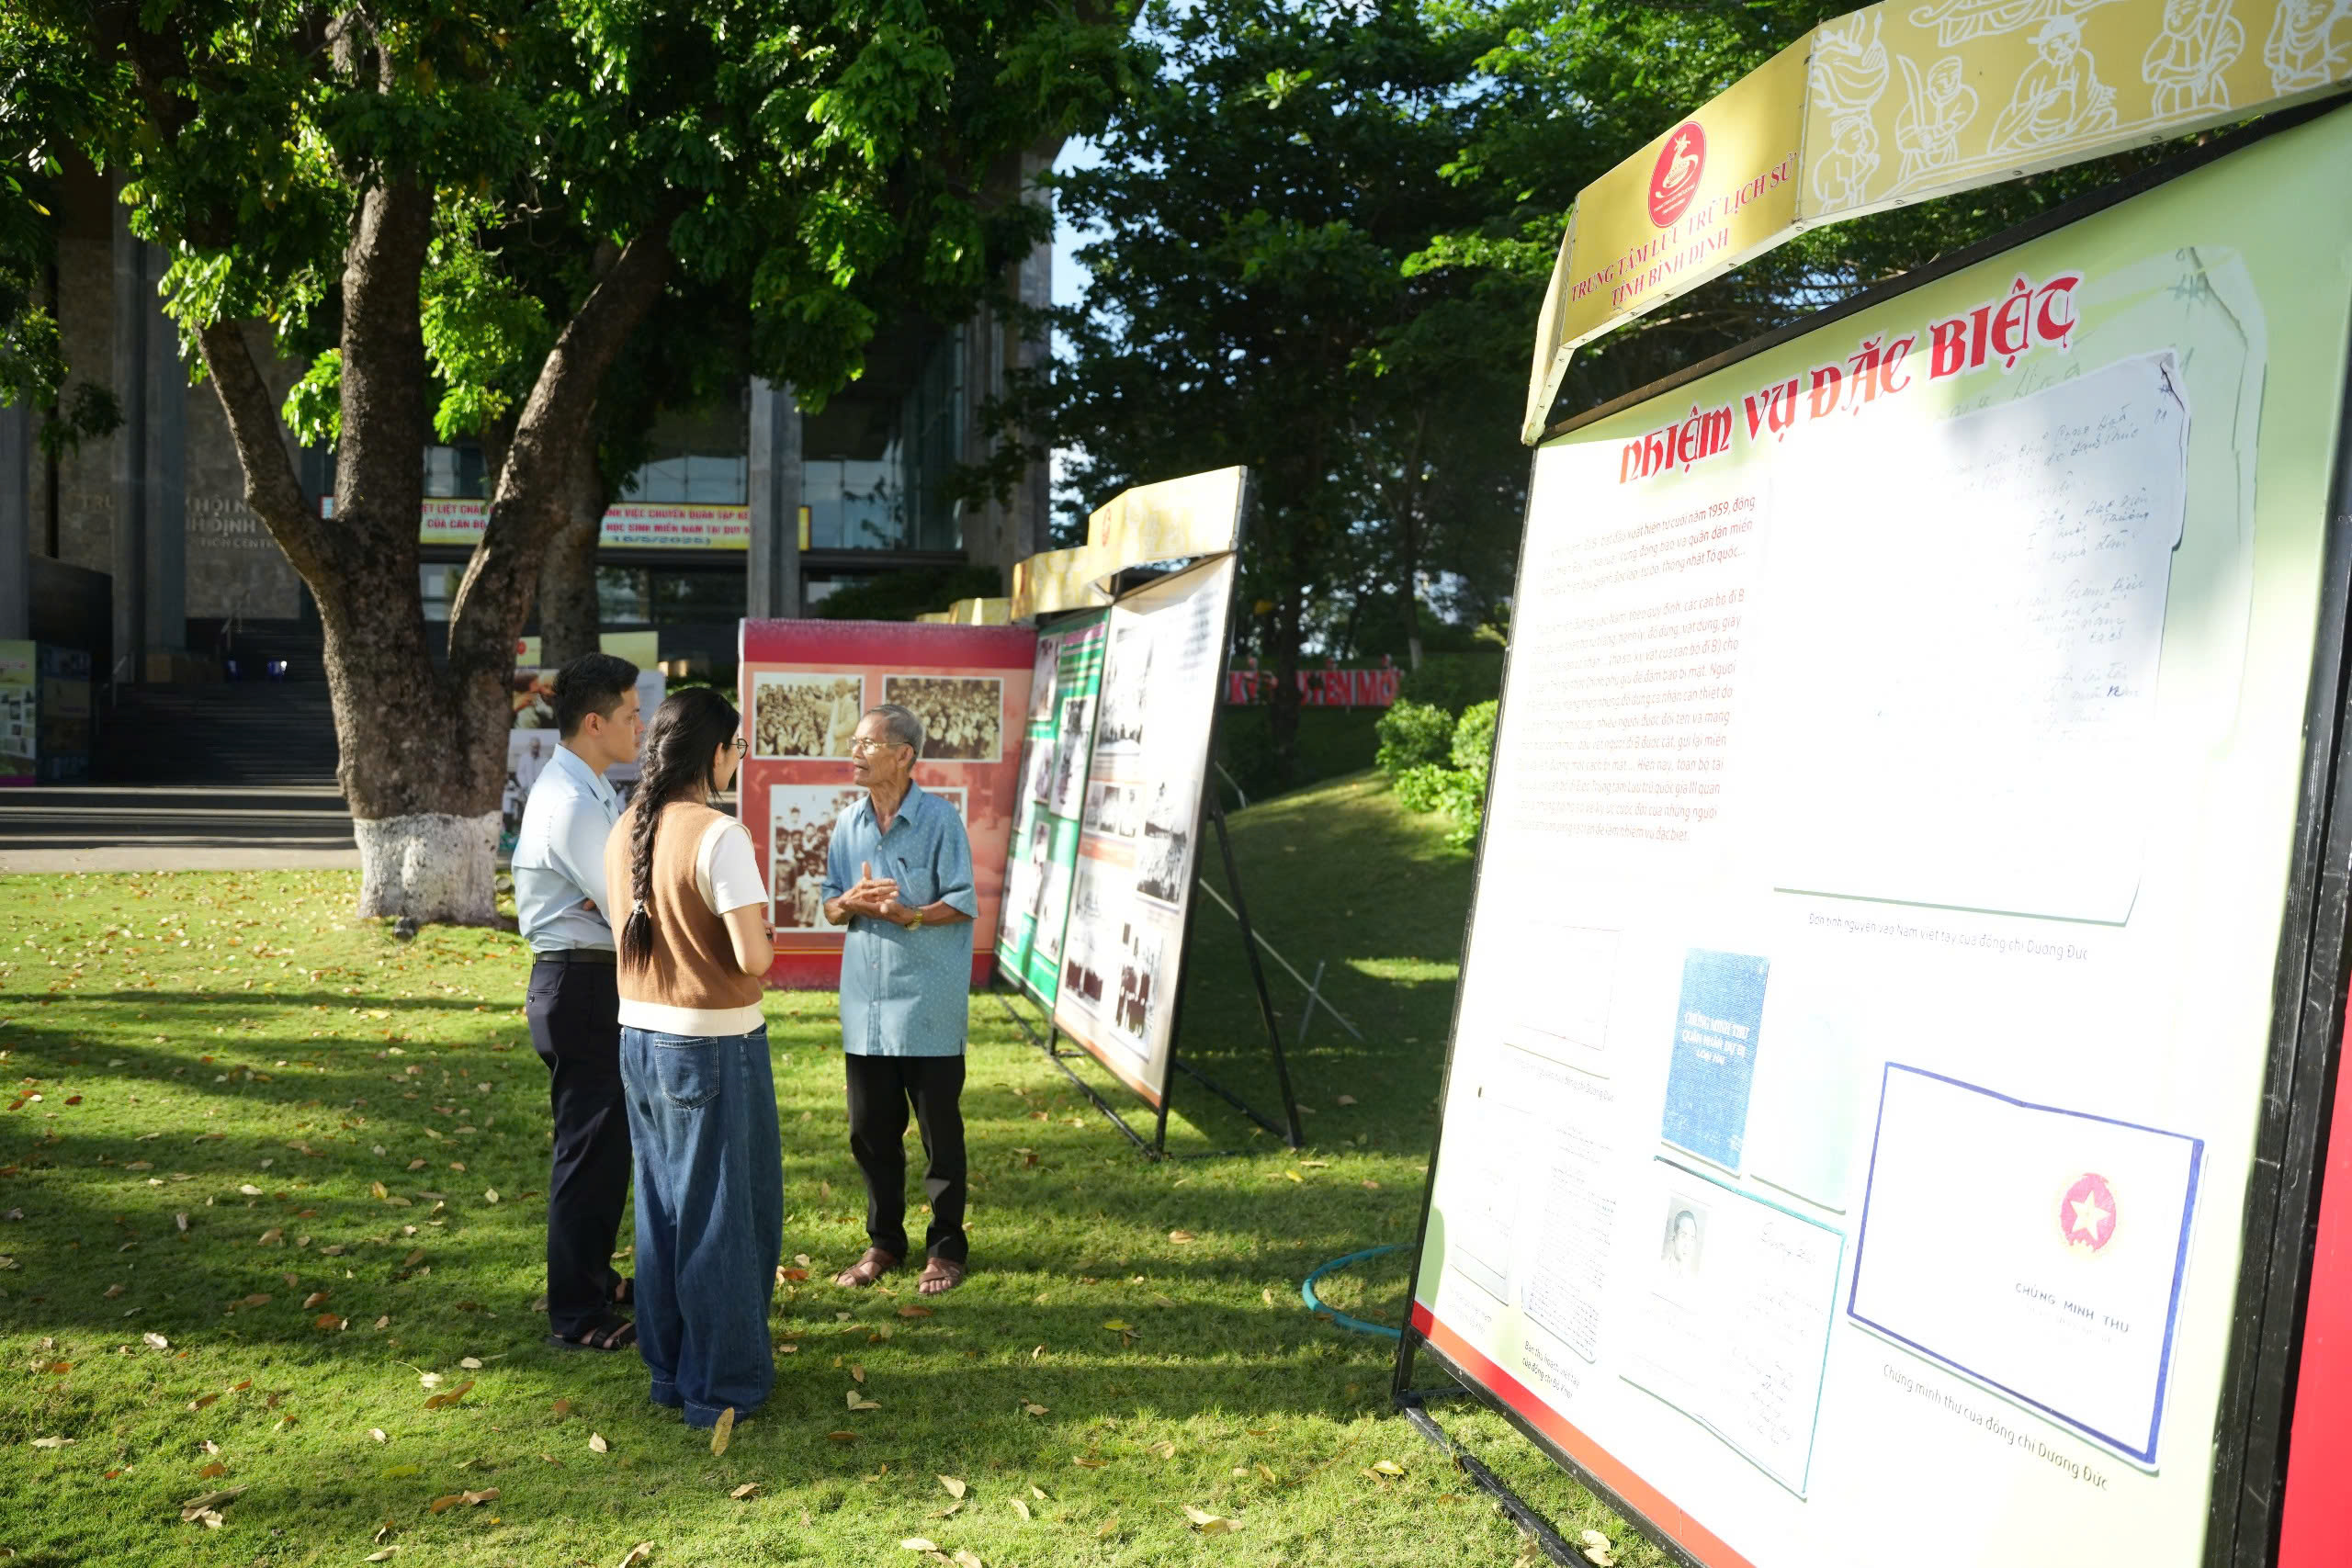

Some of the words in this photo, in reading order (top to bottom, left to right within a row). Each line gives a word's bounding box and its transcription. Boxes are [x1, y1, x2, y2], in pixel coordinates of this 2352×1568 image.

[1570, 271, 1615, 303] TRUNG
[1617, 239, 1649, 276] TÂM
[1652, 225, 1679, 260] LƯU
[1724, 173, 1767, 217] LỊCH
[1611, 275, 1645, 307] TỈNH
[1647, 253, 1685, 287] BÌNH
[1689, 227, 1729, 266] ĐỊNH
[1618, 404, 1733, 485] NHIỆM
[1743, 378, 1800, 441] VỤ
[1808, 335, 1916, 417] ĐẶC
[1928, 276, 2080, 381] BIỆT
[1688, 509, 1708, 525] năm
[1708, 501, 1731, 519] 1959,
[1737, 587, 1746, 603] B
[1723, 635, 1740, 652] cho
[1704, 710, 1731, 728] mang
[1896, 919, 1918, 939] Nam
[2064, 1300, 2095, 1320] MINH
[1916, 1382, 1941, 1404] minh
[1985, 1416, 2016, 1446] đồng
[2018, 1433, 2037, 1453] chí
[2038, 1442, 2079, 1480] Dương
[2083, 1464, 2109, 1491] Đức
